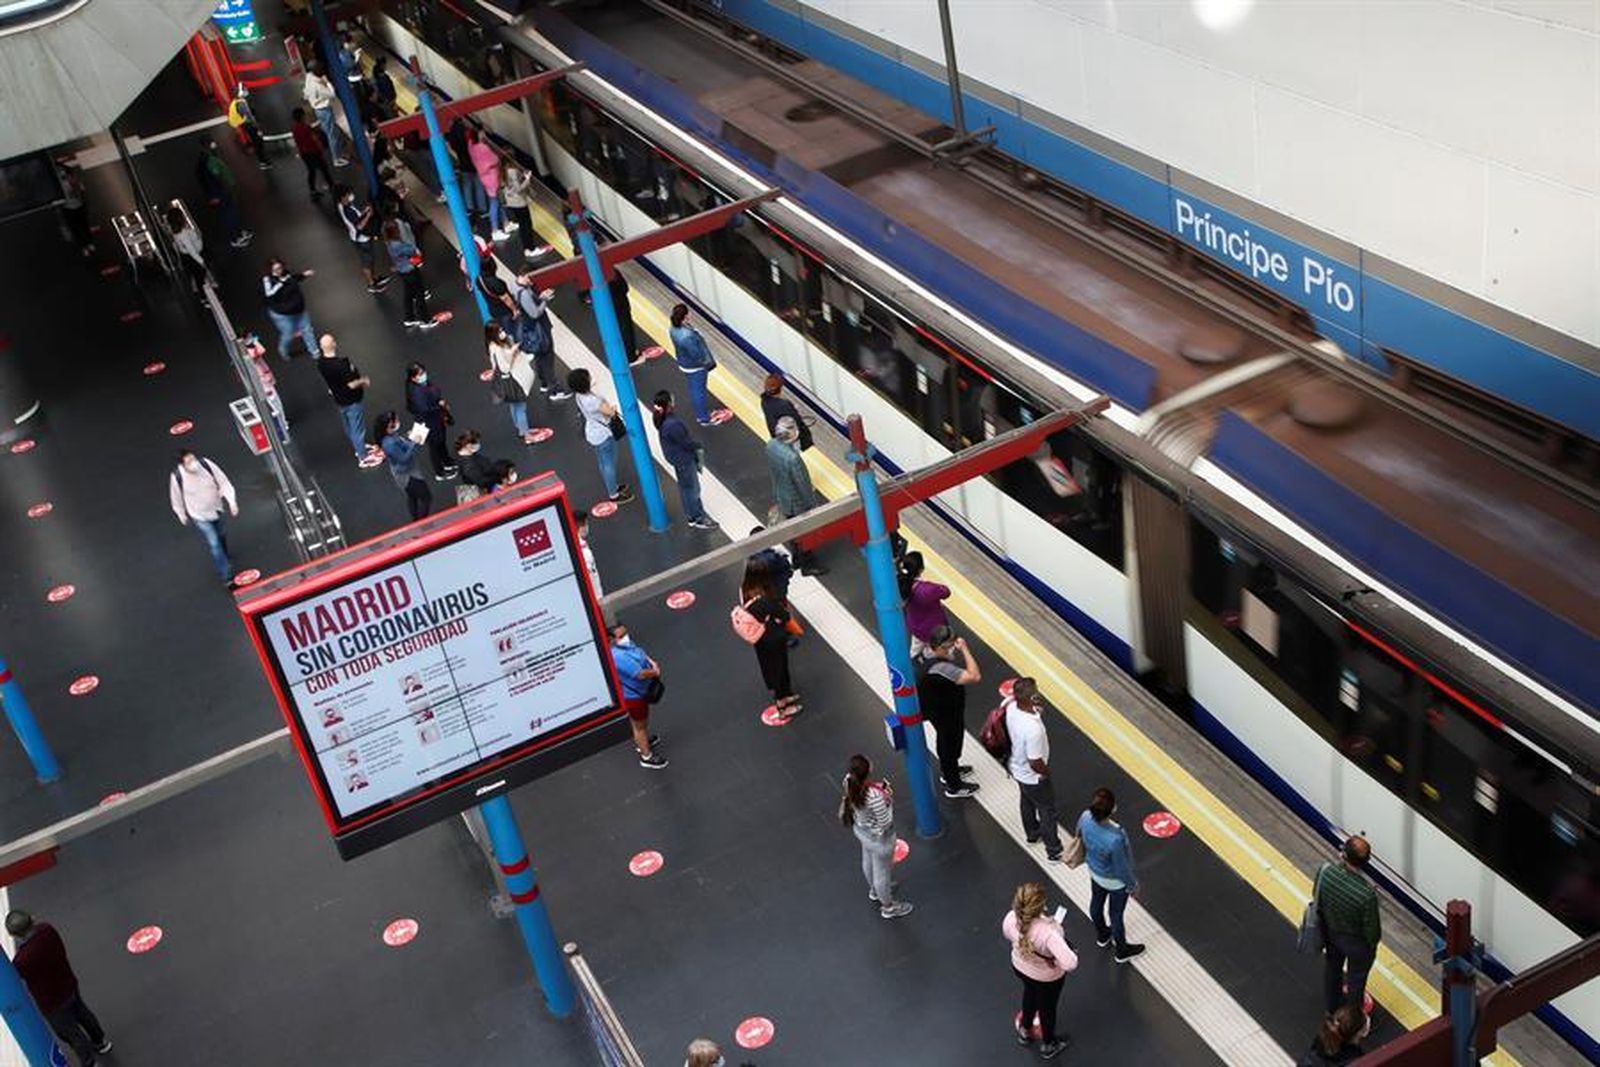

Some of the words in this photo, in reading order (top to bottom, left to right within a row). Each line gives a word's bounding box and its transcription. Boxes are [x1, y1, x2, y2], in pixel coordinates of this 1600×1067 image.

[1175, 198, 1289, 283] Príncipe
[1303, 256, 1354, 313] Pío
[281, 575, 412, 652] MADRID
[296, 642, 338, 676] SIN
[338, 582, 490, 659] CORONAVIRUS
[304, 670, 340, 695] CON
[341, 655, 383, 681] TODA
[384, 617, 469, 664] SEGURIDAD
